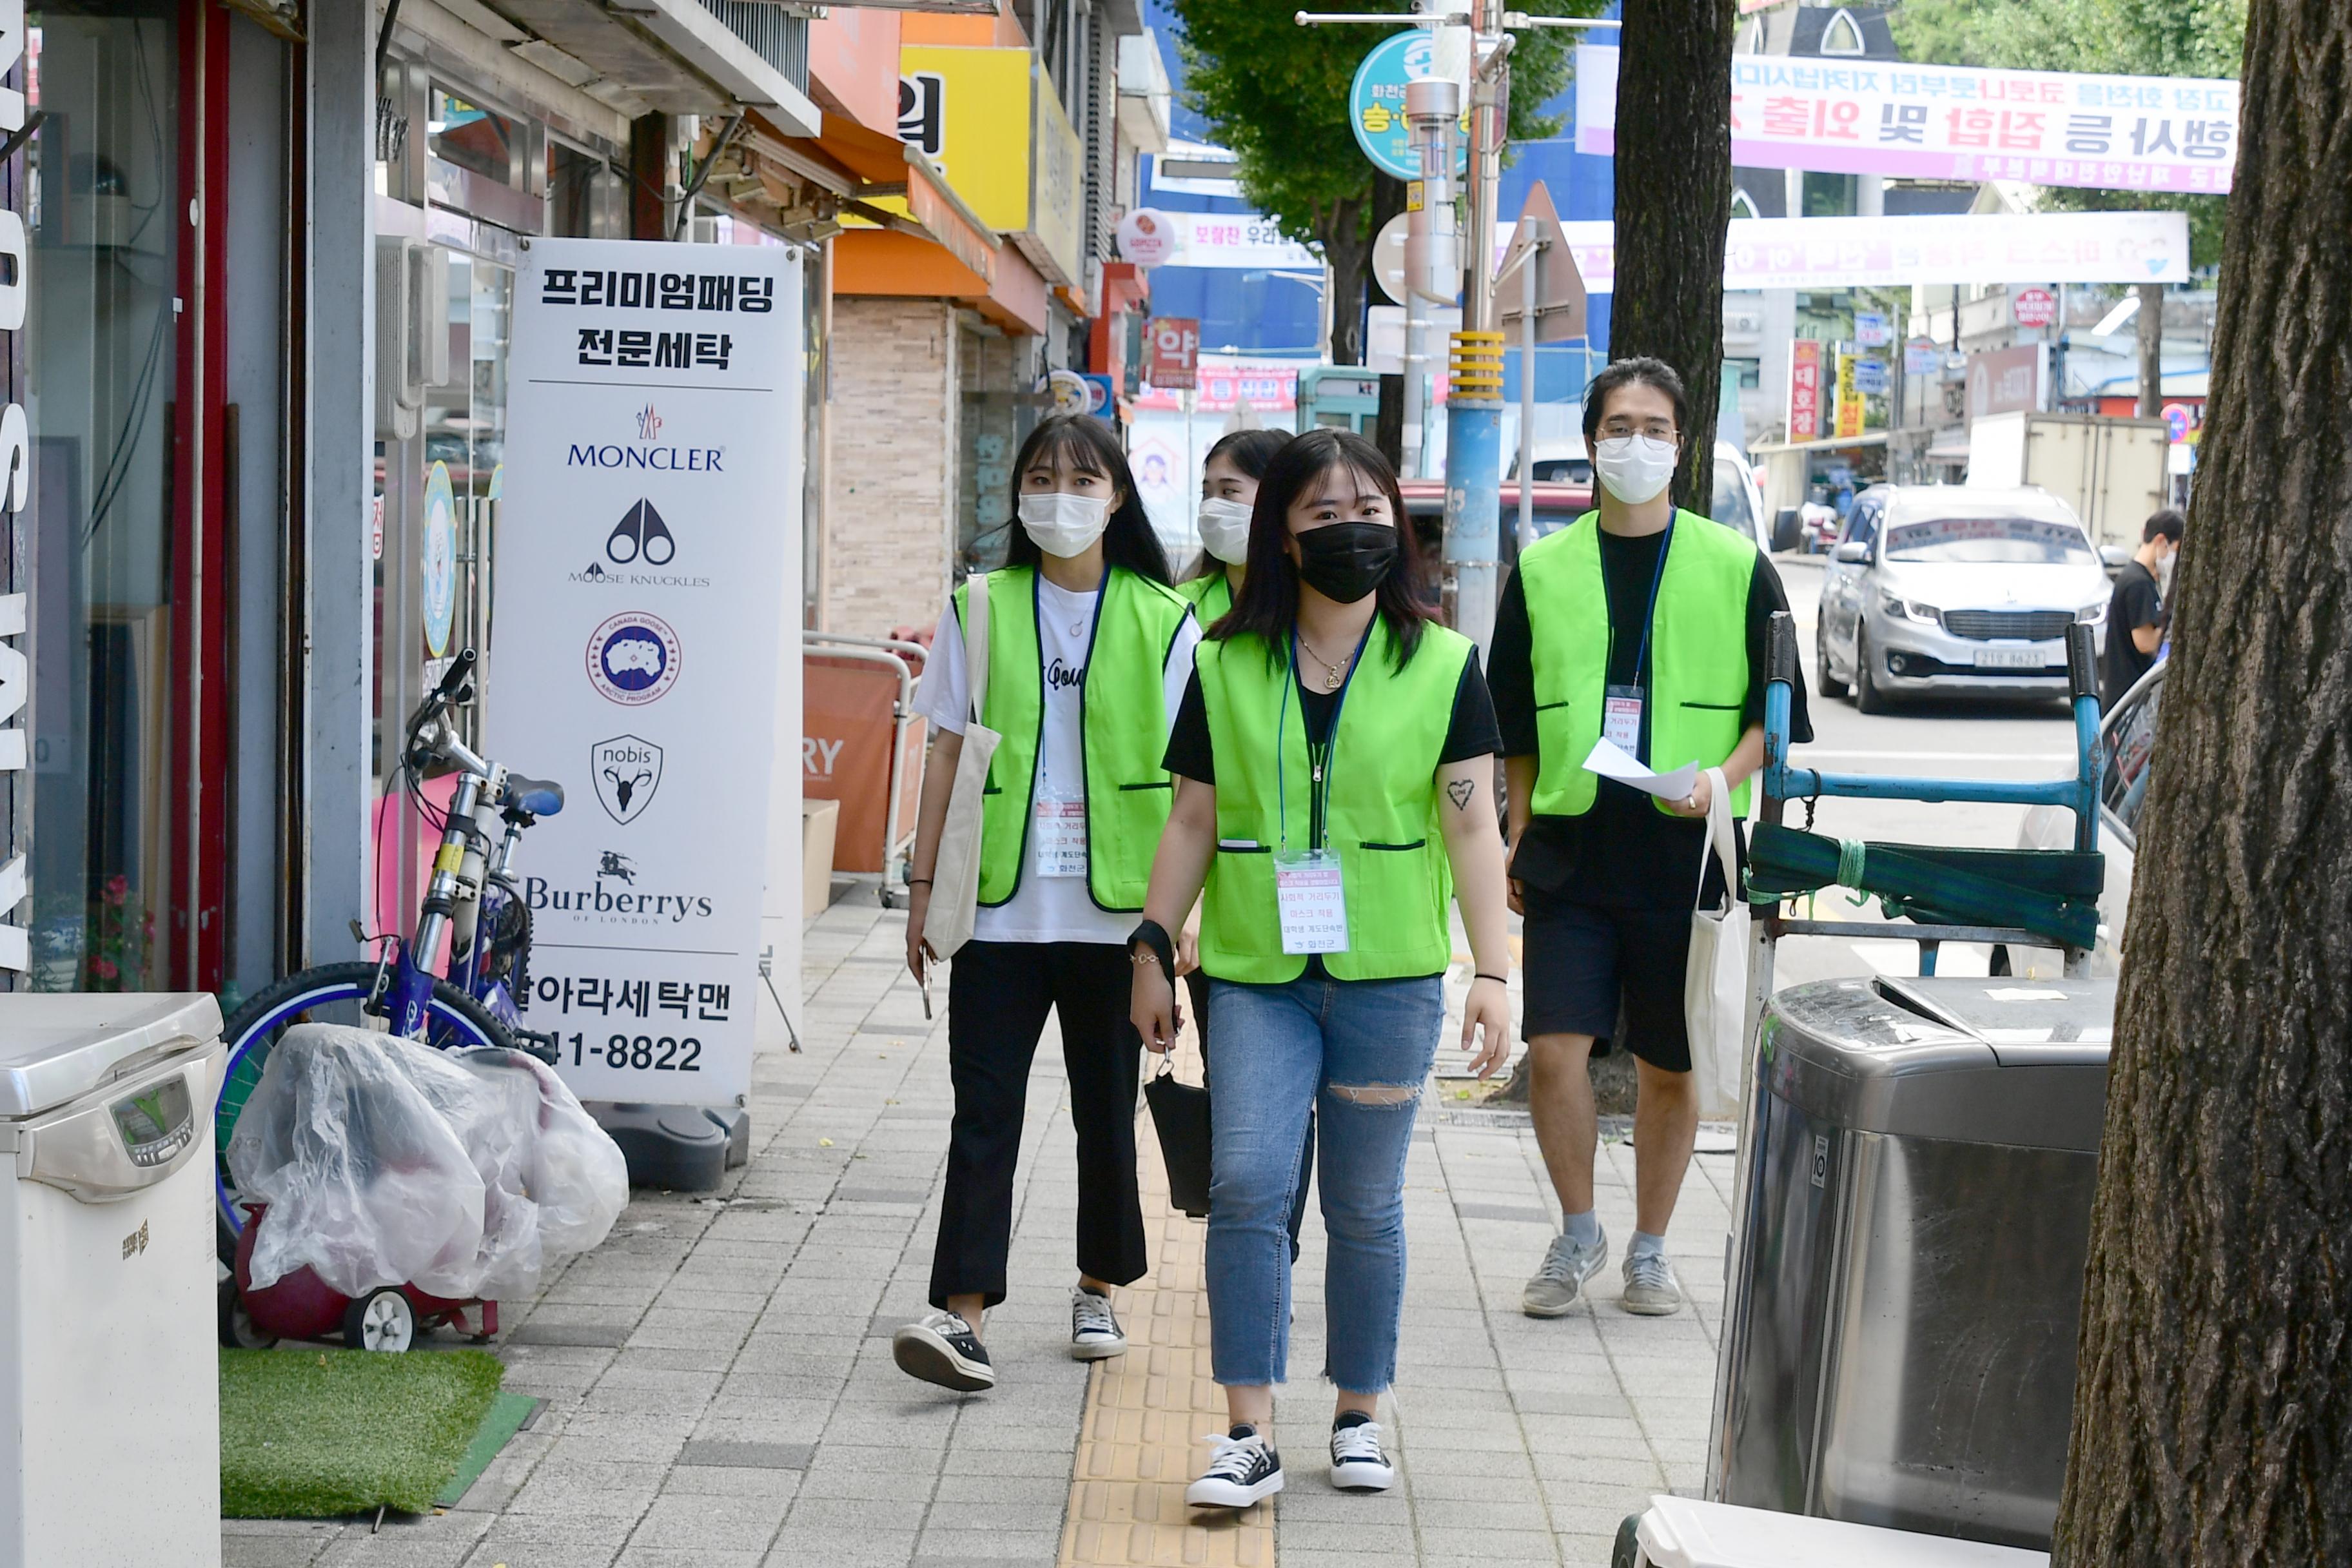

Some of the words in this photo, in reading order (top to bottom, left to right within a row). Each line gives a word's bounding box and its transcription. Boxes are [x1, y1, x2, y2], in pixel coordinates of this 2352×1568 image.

[542, 269, 773, 313] 프리미엄패딩
[578, 329, 732, 370] 전문세탁
[1157, 329, 1196, 369] 약
[567, 444, 723, 472] MONCLER
[568, 565, 624, 585] MOOSE
[630, 574, 710, 587] KNUCKLES
[609, 617, 638, 630] CANADA
[640, 618, 664, 632] GOOSE
[601, 683, 625, 700] ARCTIC
[627, 687, 662, 701] PROGRAM
[603, 747, 651, 764] nobis
[525, 877, 712, 923] Burberrys
[1309, 892, 1340, 901] 거리두기
[600, 916, 659, 925] LONDON
[1291, 910, 1313, 918] 마스크
[1318, 909, 1333, 917] 착용
[1308, 940, 1335, 948] 화천군
